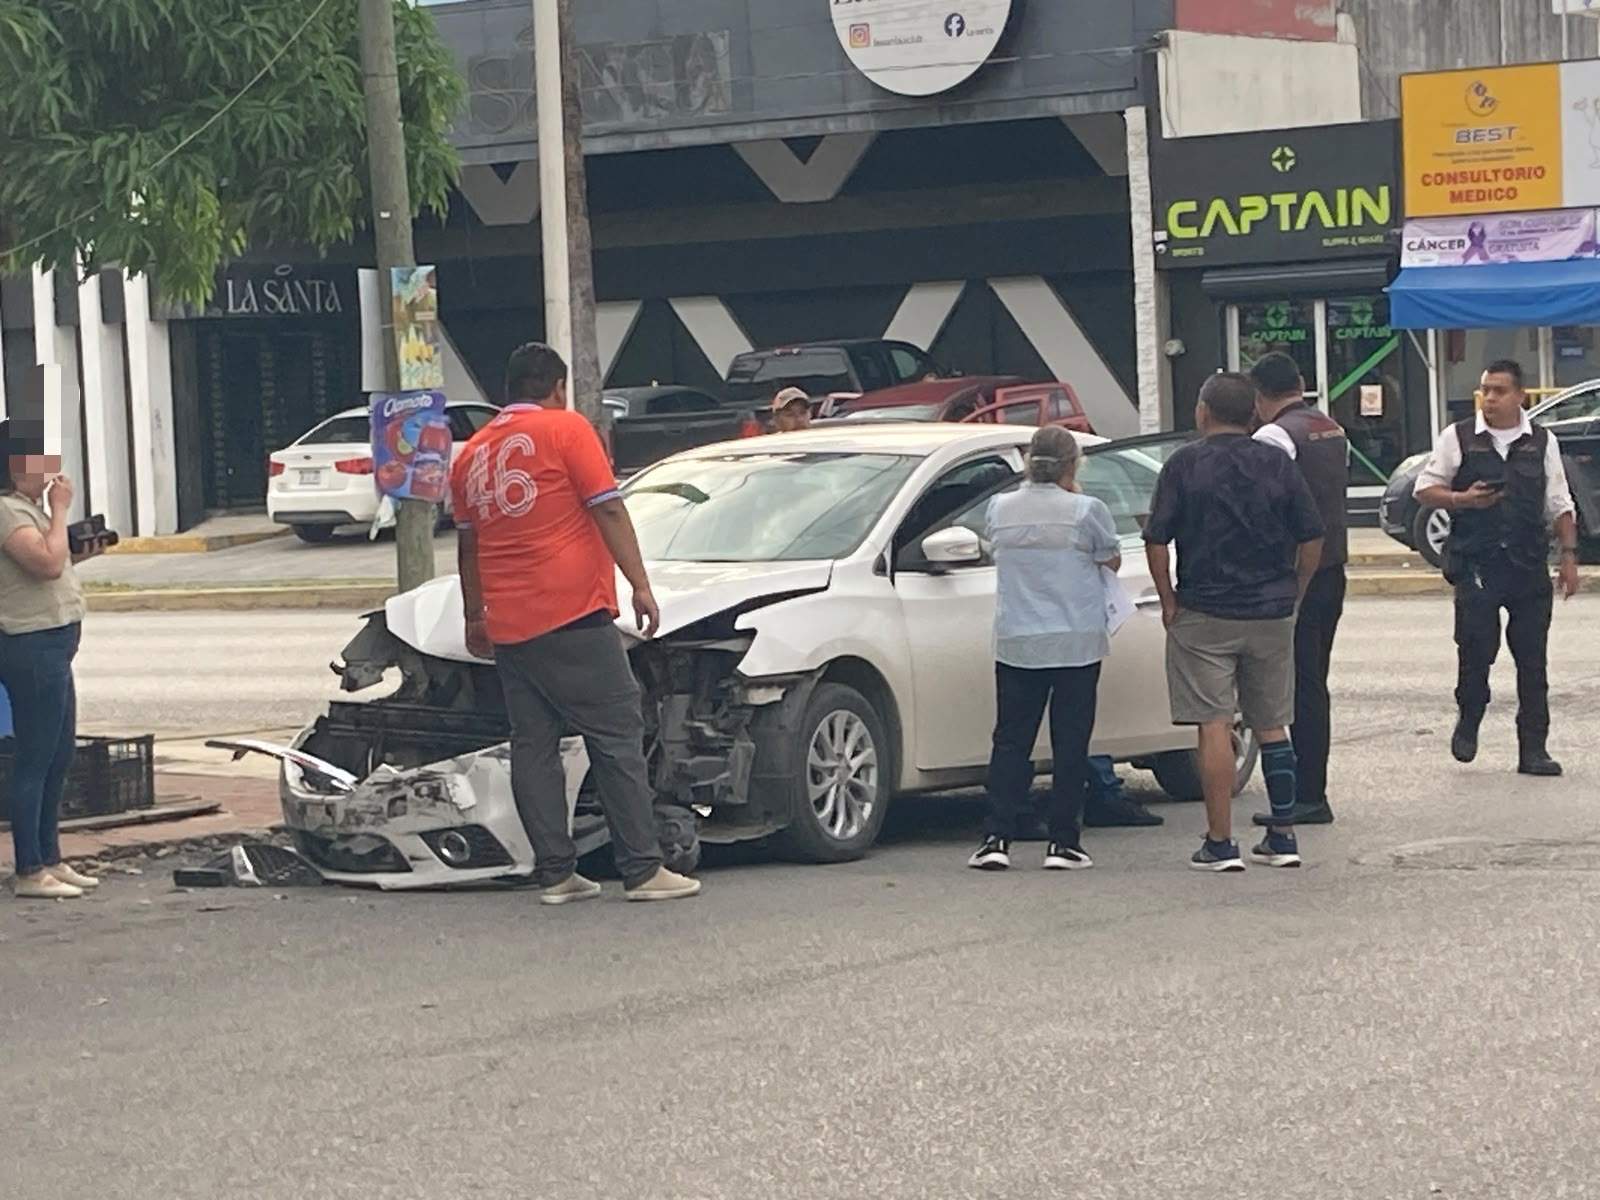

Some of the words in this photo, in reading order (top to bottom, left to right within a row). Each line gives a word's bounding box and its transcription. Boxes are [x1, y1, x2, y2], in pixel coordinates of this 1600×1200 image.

[1456, 126, 1519, 144] BEST
[1421, 166, 1547, 187] CONSULTORIO
[1449, 187, 1518, 204] MEDICO
[1167, 185, 1391, 239] CAPTAIN
[1406, 237, 1466, 252] CÁNCER
[226, 279, 259, 313] LA
[263, 279, 342, 313] SANTA
[1251, 329, 1306, 342] CAPTAIN
[465, 433, 538, 520] 46
